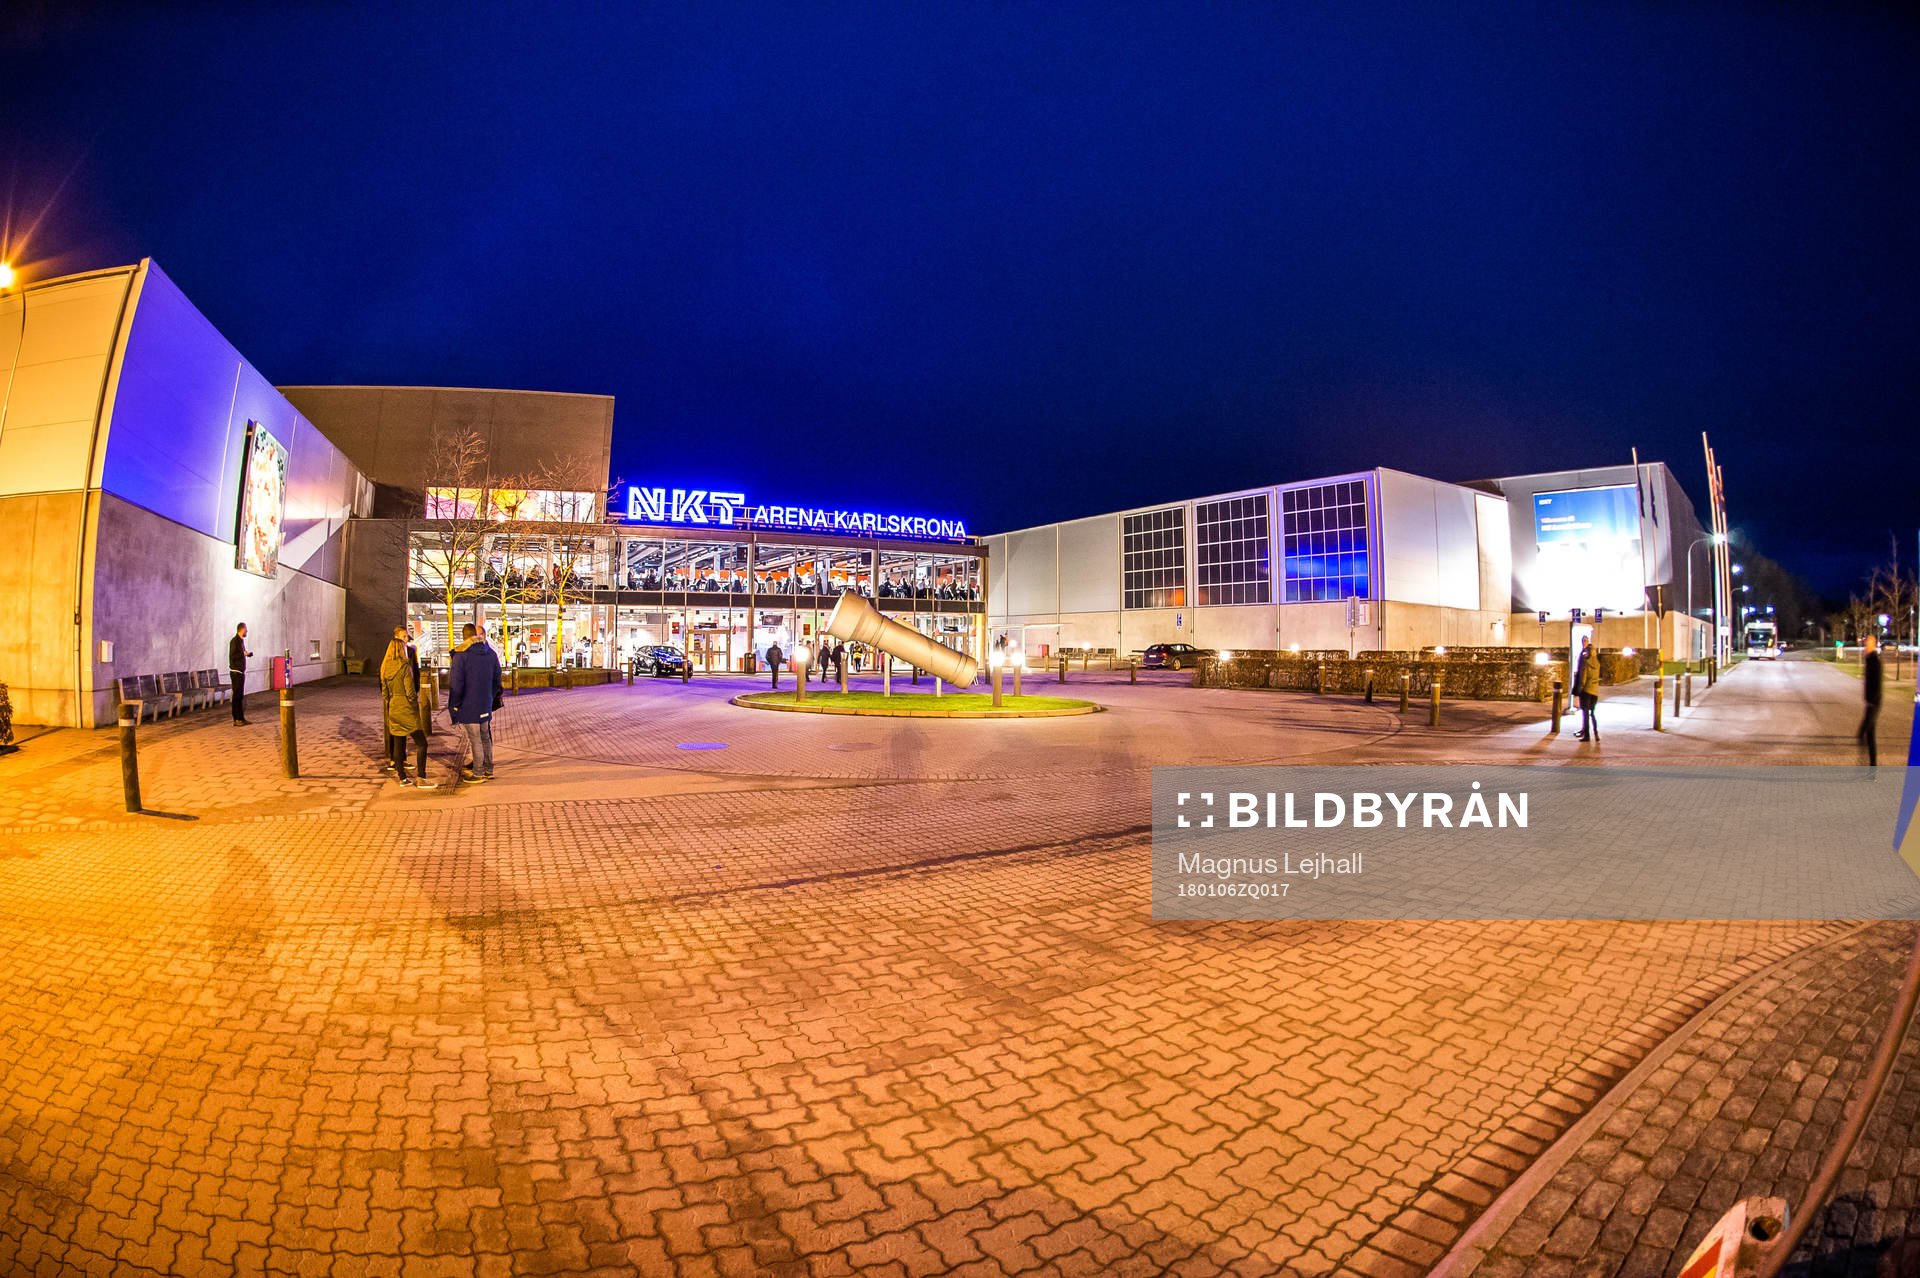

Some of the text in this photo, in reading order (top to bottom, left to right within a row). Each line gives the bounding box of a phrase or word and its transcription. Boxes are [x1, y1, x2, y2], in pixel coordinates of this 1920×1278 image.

[628, 486, 966, 537] NKT ARENA KARLSKRONA
